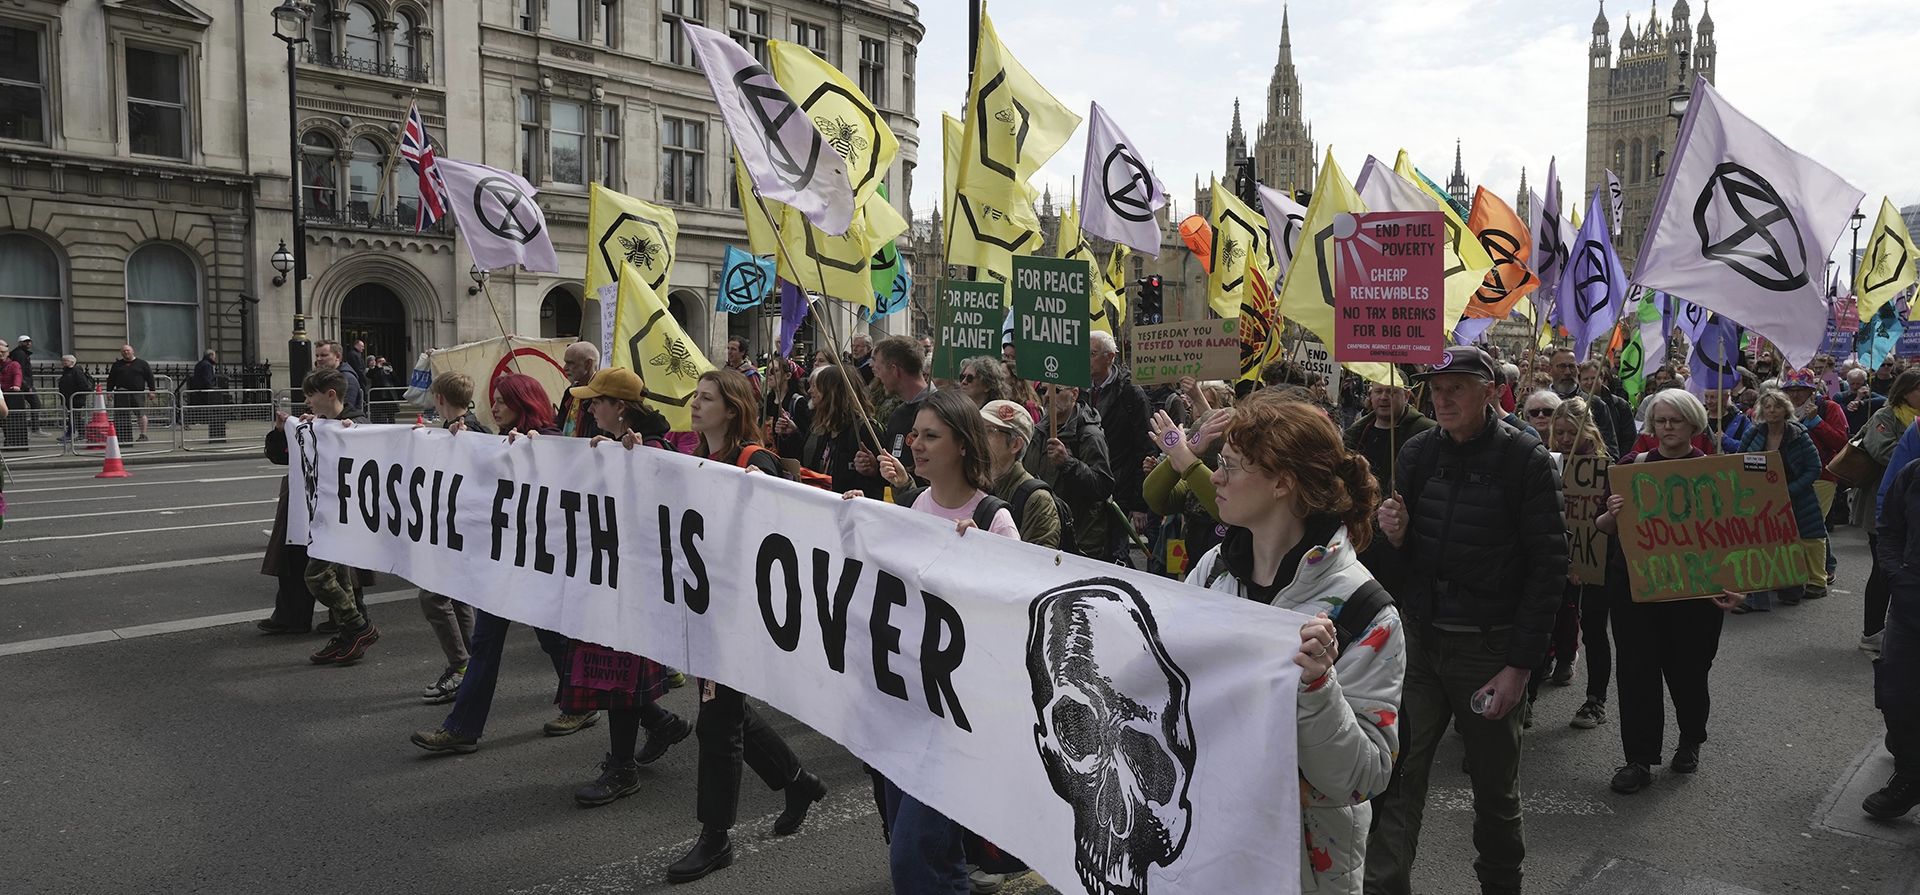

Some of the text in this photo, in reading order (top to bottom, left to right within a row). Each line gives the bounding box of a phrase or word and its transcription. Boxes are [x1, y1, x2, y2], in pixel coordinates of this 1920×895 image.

[1375, 224, 1435, 237] END FUEL
[1381, 243, 1435, 256] POVERTY
[1017, 268, 1084, 295] FOR PEACE
[1370, 268, 1408, 282] CHEAP
[943, 289, 999, 309] OR PEACE
[1350, 286, 1429, 300] RENEWABLES
[1034, 296, 1067, 314] AND
[953, 312, 983, 325] AND
[1343, 307, 1436, 320] NO TAX BREAKS
[1022, 314, 1081, 346] PLANET
[1137, 326, 1212, 341] YESTERDAY YOU
[1353, 324, 1425, 338] FOR BIG OIL
[942, 326, 995, 349] PLANET
[1137, 340, 1174, 351] TESTED
[1178, 339, 1203, 348] YOUR
[1136, 352, 1203, 364] NOW WILL YOU
[1308, 349, 1328, 361] END
[1137, 362, 1201, 377] ACT ON IT?
[1300, 360, 1332, 374] FOSSIL
[1696, 515, 1762, 550] KNOW
[338, 457, 972, 733] FOSSIL FILTH IS OVER
[583, 651, 632, 668] UNITE TO
[583, 666, 629, 680] SURVIVE
